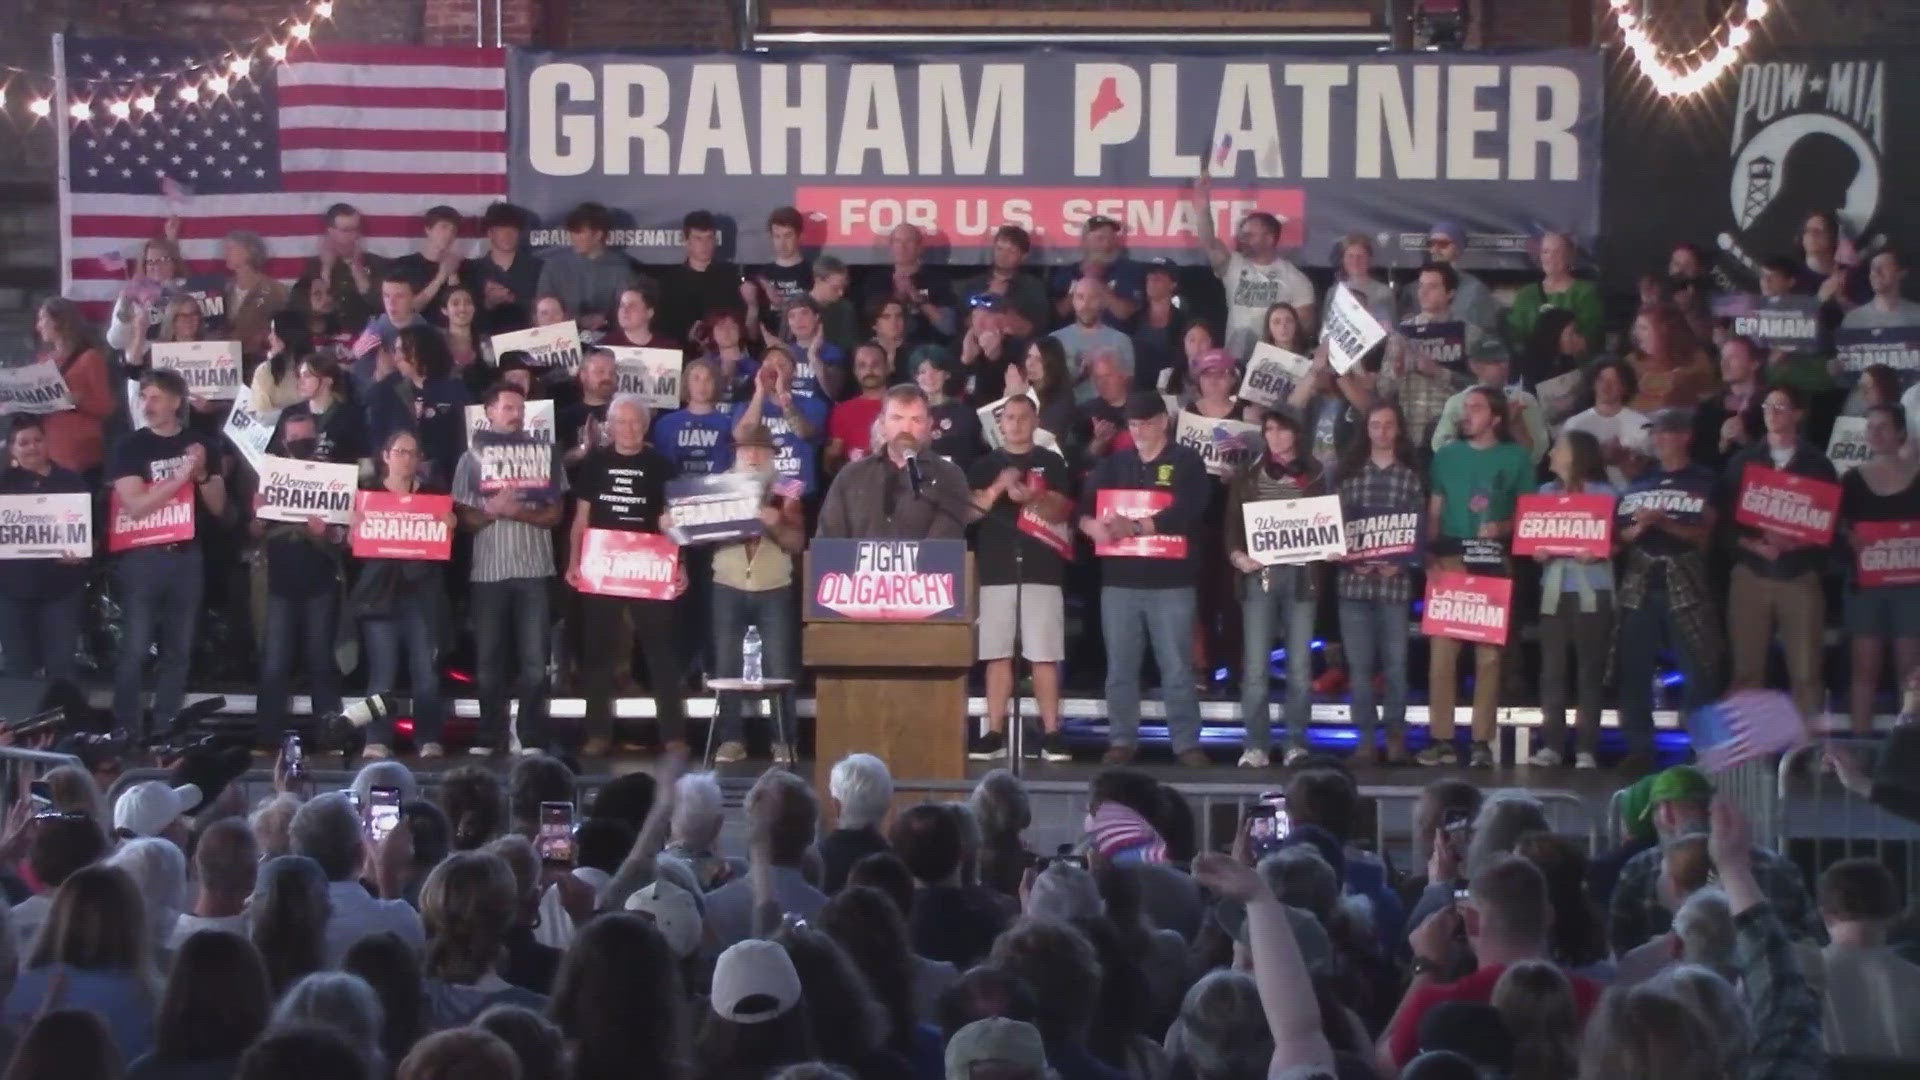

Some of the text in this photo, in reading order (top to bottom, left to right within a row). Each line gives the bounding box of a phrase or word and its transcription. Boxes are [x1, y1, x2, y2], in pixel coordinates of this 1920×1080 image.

[1729, 60, 1885, 156] POW MIA
[529, 63, 1579, 181] GRAHAM PLATNER
[840, 198, 938, 236] FOR
[955, 199, 1045, 236] U.S.
[182, 368, 238, 387] AHAM
[678, 429, 719, 447] UAW
[270, 471, 348, 490] Women for
[264, 485, 350, 511] GRAHAM
[1255, 512, 1333, 531] Women for
[1742, 491, 1832, 531] GRAHAM
[0, 523, 86, 544] GRAHAM
[360, 519, 447, 542] GRAHAM
[1345, 513, 1418, 534] GRAHAM
[1519, 519, 1606, 540] GRAHAM
[1252, 525, 1339, 552] GRAHAM
[857, 542, 919, 573] FIGHT
[818, 573, 953, 606] OLIGARCHY
[1432, 588, 1488, 604] LABOR
[1427, 599, 1505, 628] GRAHAM
